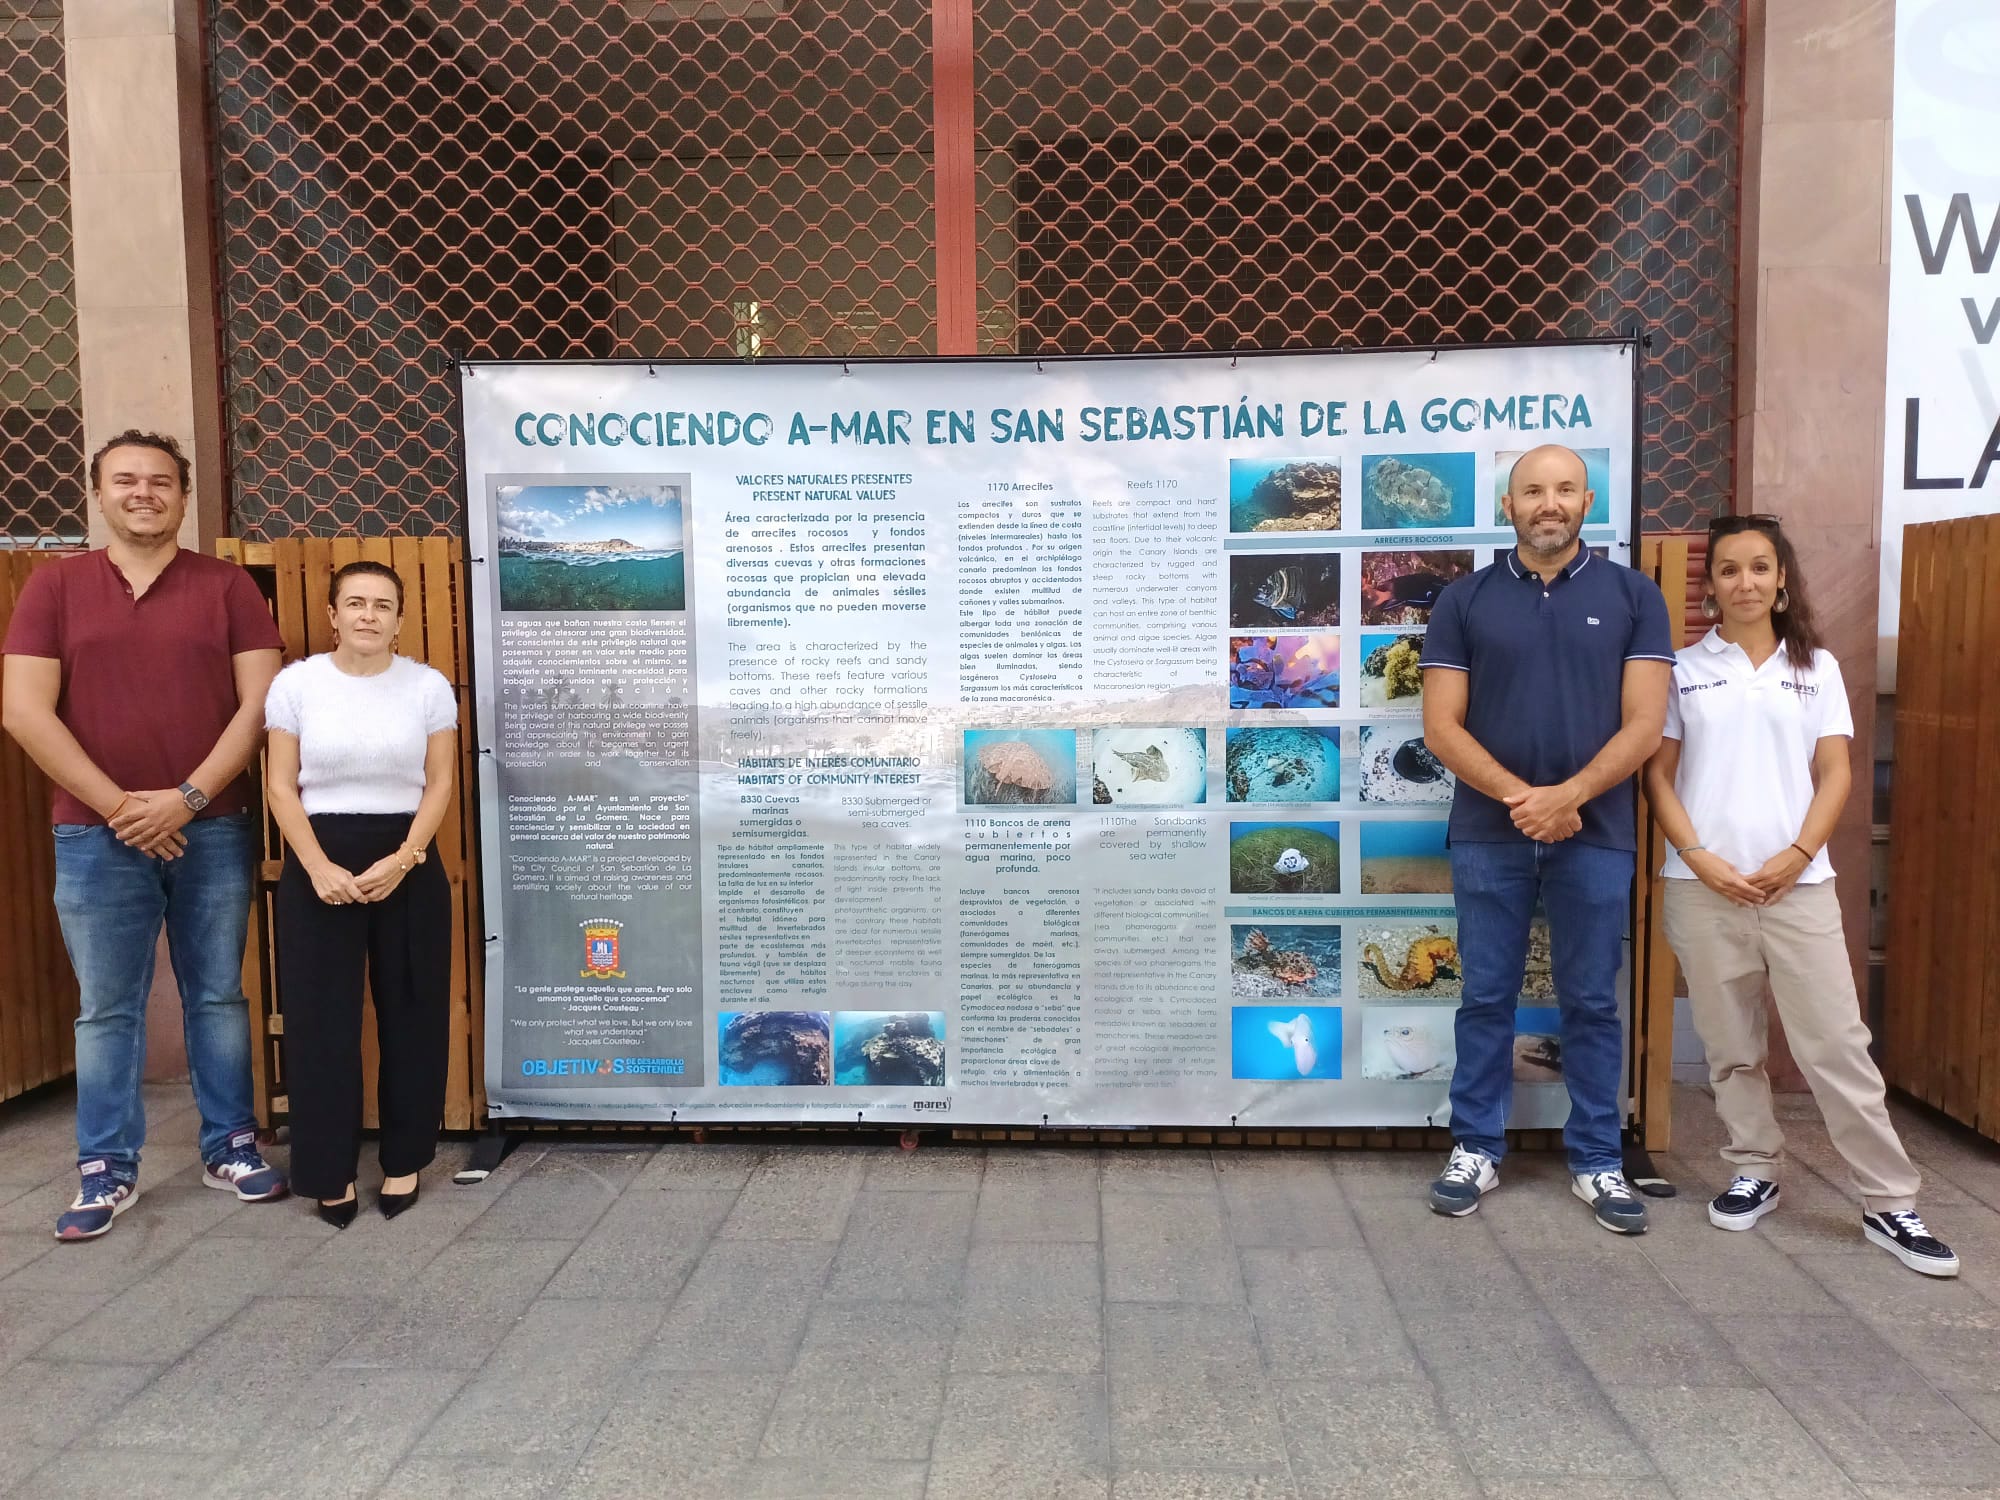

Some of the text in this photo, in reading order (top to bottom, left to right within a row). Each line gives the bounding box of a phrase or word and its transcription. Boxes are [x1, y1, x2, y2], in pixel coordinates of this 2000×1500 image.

[514, 393, 1593, 447] CONOCIENDO A-MAR EN SAN SEBASTIÁN DE LA GOMERA
[736, 474, 912, 485] VALORES NATURALES PRESENTES
[1128, 480, 1177, 489] Reefs 1170
[988, 482, 1053, 491] 1170 Arrecifes
[753, 490, 895, 501] PRESENT NATURAL VALUES
[725, 512, 925, 524] Área caracterizada por la presencia
[725, 527, 925, 538] de arrecifes rocosos y fondos
[726, 542, 925, 554] arenosos Estos arrecifes presentan
[726, 557, 926, 569] diversas cuevas y otras formaciones
[727, 572, 926, 584] rocosas que propician una elevada
[727, 587, 926, 598] abundancia de animales sésiles
[727, 603, 926, 614] (organismos que no pueden moverse
[728, 641, 927, 652] The area is characterized by the
[729, 656, 927, 668] presence of rocky reefs and sandy
[730, 671, 927, 681] bottoms. These reefs feature various
[730, 685, 927, 696] caves and other rocky formations
[738, 756, 920, 768] HÁBITATS DE INTERÉS COMUNITARIO
[738, 774, 921, 784] HABITATS OF COMMUNITY INTEREST
[740, 795, 799, 803] 8330 Cuevas
[841, 797, 863, 805] 8330
[865, 797, 919, 807] Submerged
[752, 806, 788, 814] marinas
[848, 808, 925, 818] semi-submerged
[740, 818, 792, 827] sumergidas
[862, 820, 878, 828] sea
[965, 819, 986, 827] 1110
[990, 819, 1023, 827] Bancos
[1027, 819, 1039, 827] de
[1154, 817, 1206, 825] Sandbanks
[1146, 829, 1206, 838] permanently
[965, 842, 1070, 851] permanentemente por
[1100, 840, 1206, 850] covered by shallow
[965, 854, 989, 863] agua
[1046, 854, 1070, 862] poco
[1149, 852, 1176, 860] water
[530, 986, 551, 994] gente
[554, 986, 584, 994] protege
[587, 986, 615, 994] aquello
[913, 1100, 947, 1111] mares
